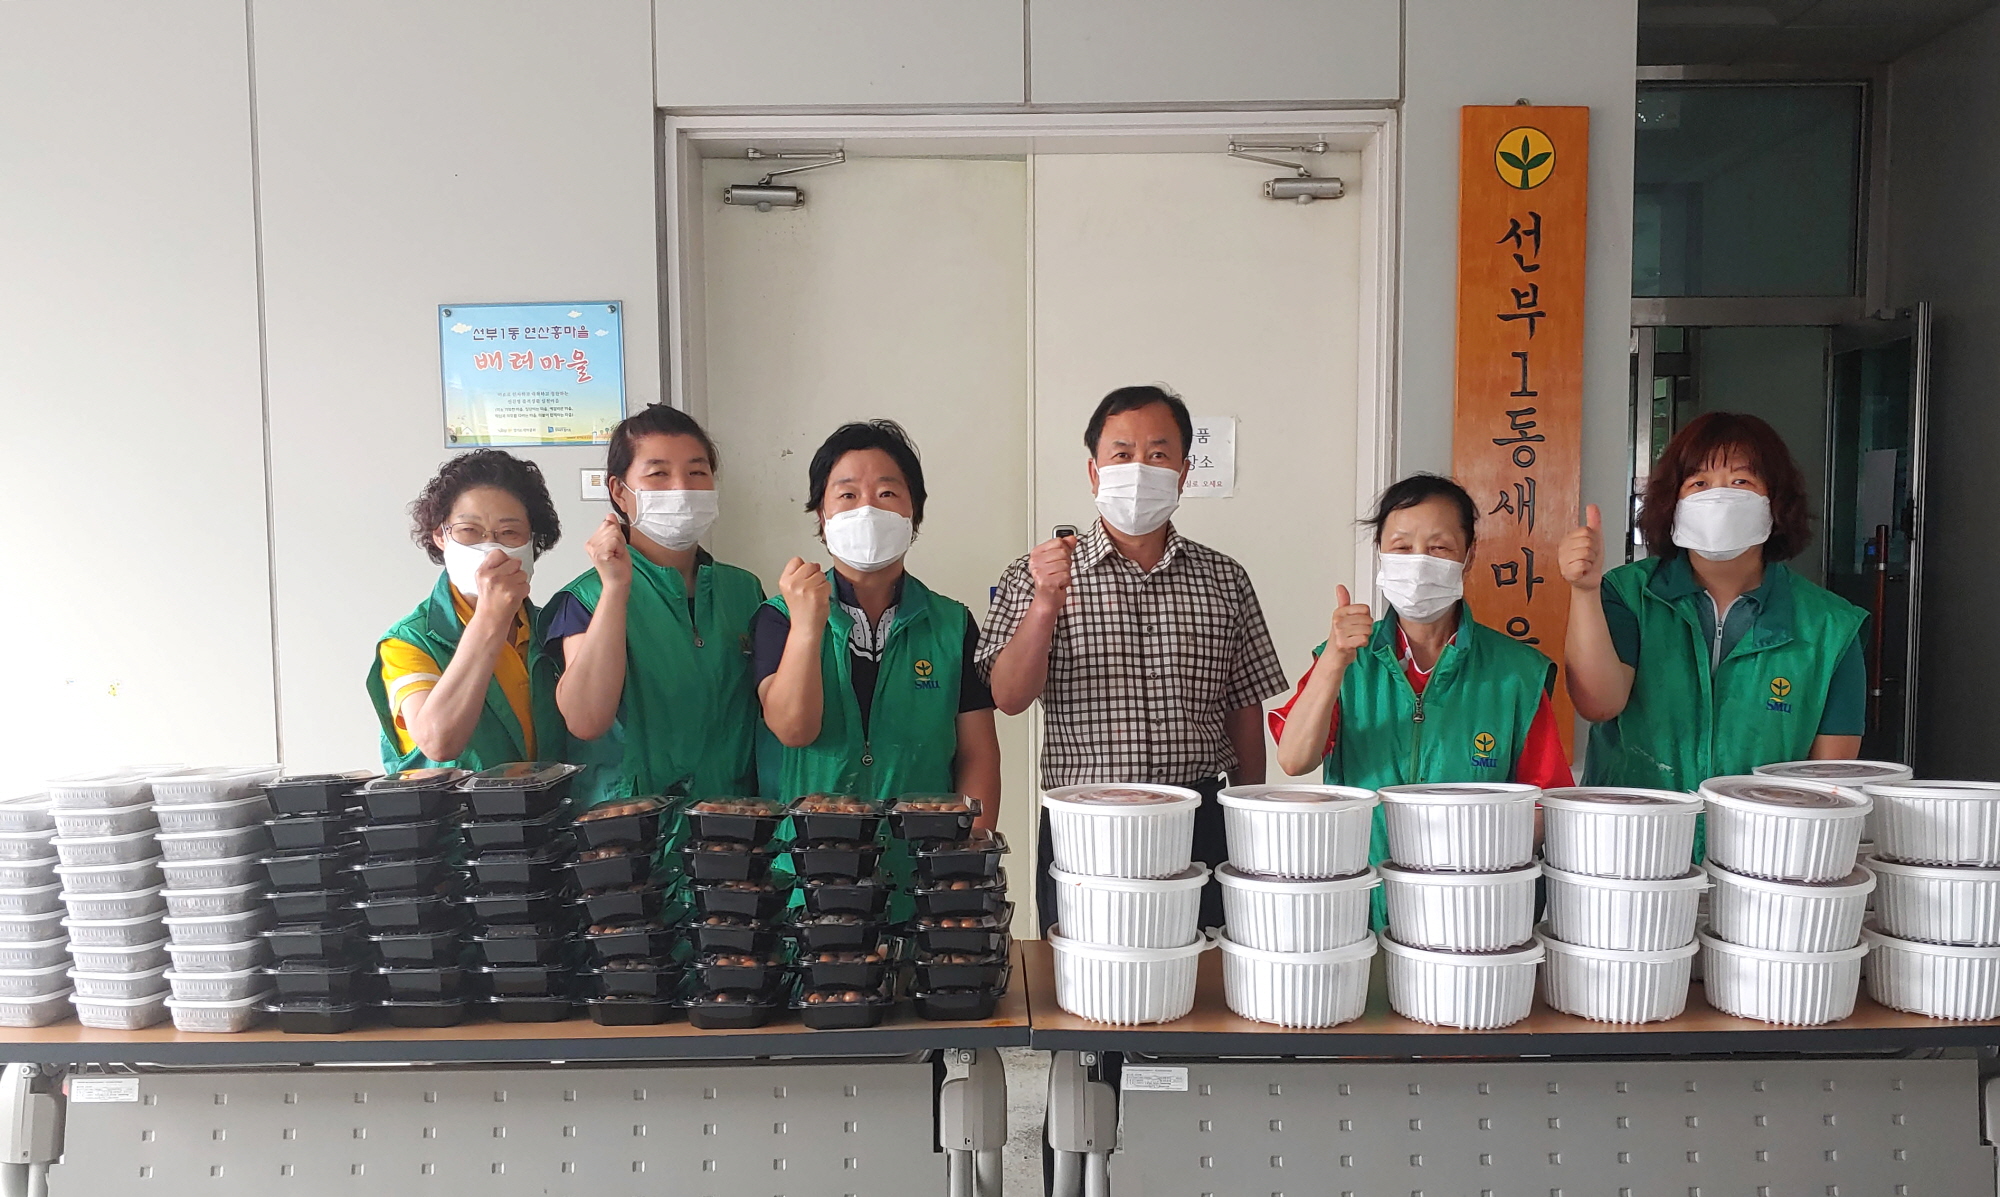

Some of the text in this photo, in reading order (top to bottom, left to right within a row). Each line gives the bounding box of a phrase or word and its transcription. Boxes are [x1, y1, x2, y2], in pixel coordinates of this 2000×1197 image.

[473, 325, 590, 341] 선부1동 연산홍마을
[1202, 480, 1223, 488] 오세요
[914, 680, 941, 690] SMU
[1766, 700, 1792, 713] SMU
[1471, 755, 1498, 768] SMU
